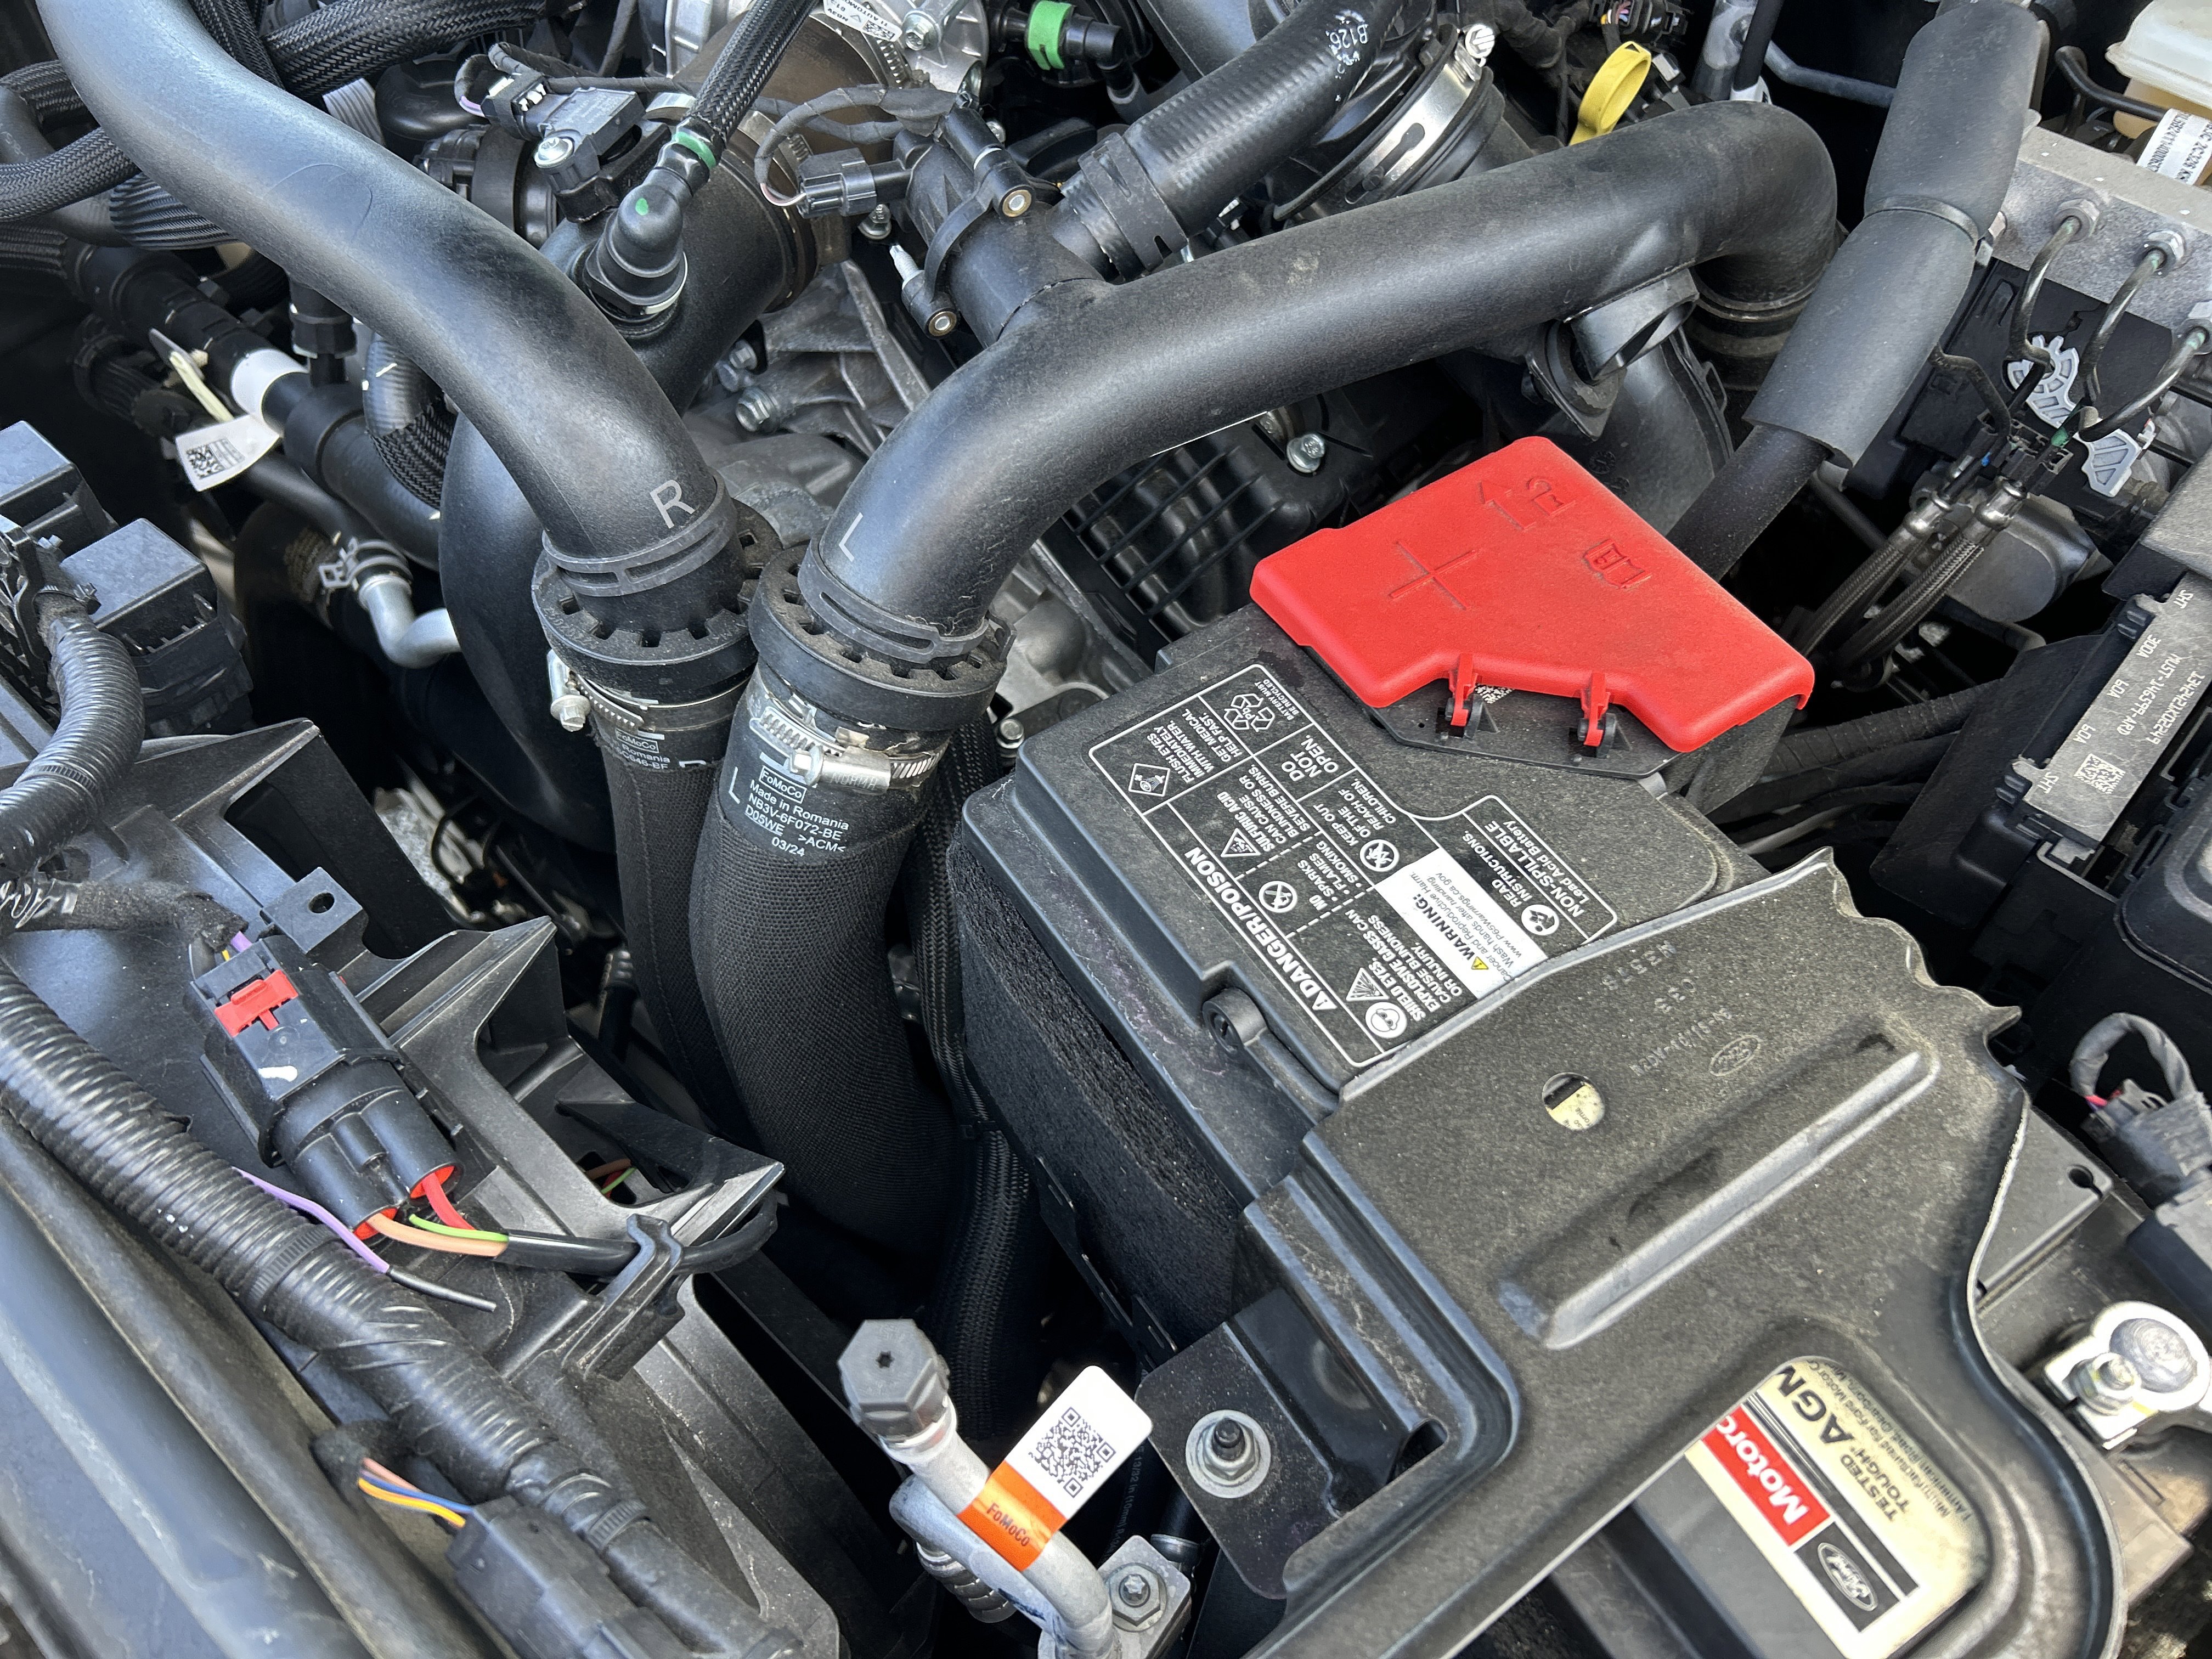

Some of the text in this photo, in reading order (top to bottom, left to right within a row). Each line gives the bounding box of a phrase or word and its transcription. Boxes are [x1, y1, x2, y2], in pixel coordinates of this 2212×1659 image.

[1329, 24, 1368, 50] B126
[650, 479, 695, 528] R
[838, 512, 864, 561] L
[2136, 634, 2162, 657] 300A
[1255, 681, 1294, 720] BATTERY MUST
[1263, 679, 1299, 715] BE RECYCLED
[2107, 679, 2129, 698] 60A
[1182, 709, 1231, 761] GET MEDICAL
[1199, 713, 1243, 757] HELP FAST.
[1239, 705, 1256, 723] Pb
[2073, 724, 2096, 743] 60A
[614, 730, 657, 751] FoMoCo
[622, 743, 671, 763] Romania
[1147, 733, 1194, 783] FLUSH EYES
[1154, 726, 1205, 777] IMMEDIATELY
[1167, 720, 1214, 772] WITH WATER.
[1301, 735, 1339, 772] OPEN.
[729, 767, 740, 804] L
[760, 770, 802, 798] FoMoCo
[1282, 761, 1305, 781] DO
[1290, 752, 1322, 777] NOT
[749, 793, 843, 840] NB3V-6F072-BE
[751, 780, 849, 830] Made in Romania
[1239, 775, 1299, 837] BLINDNESS OR
[1249, 765, 1310, 831] SEVERE BURNS.
[1338, 789, 1384, 830] REACH OF
[1351, 778, 1396, 823] CHILDREN.
[745, 804, 846, 851] D05WE >ACM<
[1217, 792, 1275, 851] SULFURIC ACID
[1239, 795, 1286, 844] CAN CAUSE
[1313, 804, 1358, 846] KEEP OUT
[1338, 806, 1371, 837] OF THE
[772, 837, 804, 856] 03/24
[1316, 840, 1358, 883] SMOKING
[1463, 831, 1533, 901] INSTRUCTIONS.
[1503, 821, 1589, 904] Lead Acid Battery
[1297, 860, 1334, 896] SPARKS
[1309, 853, 1347, 890] FLAMES
[1411, 873, 1431, 893] Harm.
[1485, 821, 1584, 917] NON-SPILLABLE
[1309, 895, 1328, 910] NO
[1456, 906, 1472, 920] after
[1492, 879, 1522, 907] READ
[1184, 847, 1321, 997] DANGER/POISON
[1413, 894, 1475, 960] WARNING:
[1430, 894, 1474, 940] Reproductive
[1472, 921, 1494, 945] hands
[1345, 910, 1441, 1012] EXPLOSIVE GASES CAN
[1368, 915, 1452, 1003] CAUSE BLINDNESS
[1470, 939, 1488, 953] and
[1493, 944, 1514, 968] Wash
[1369, 958, 1425, 1021] SHIELD EYES.
[1411, 943, 1462, 996] OR INJURY.
[1814, 1365, 1850, 1403] Motor
[1841, 1396, 1870, 1426] Ford
[1839, 1453, 1897, 1521] TESTED
[986, 1503, 1030, 1547] FoMoCo
[1825, 1554, 1872, 1600] Ford
